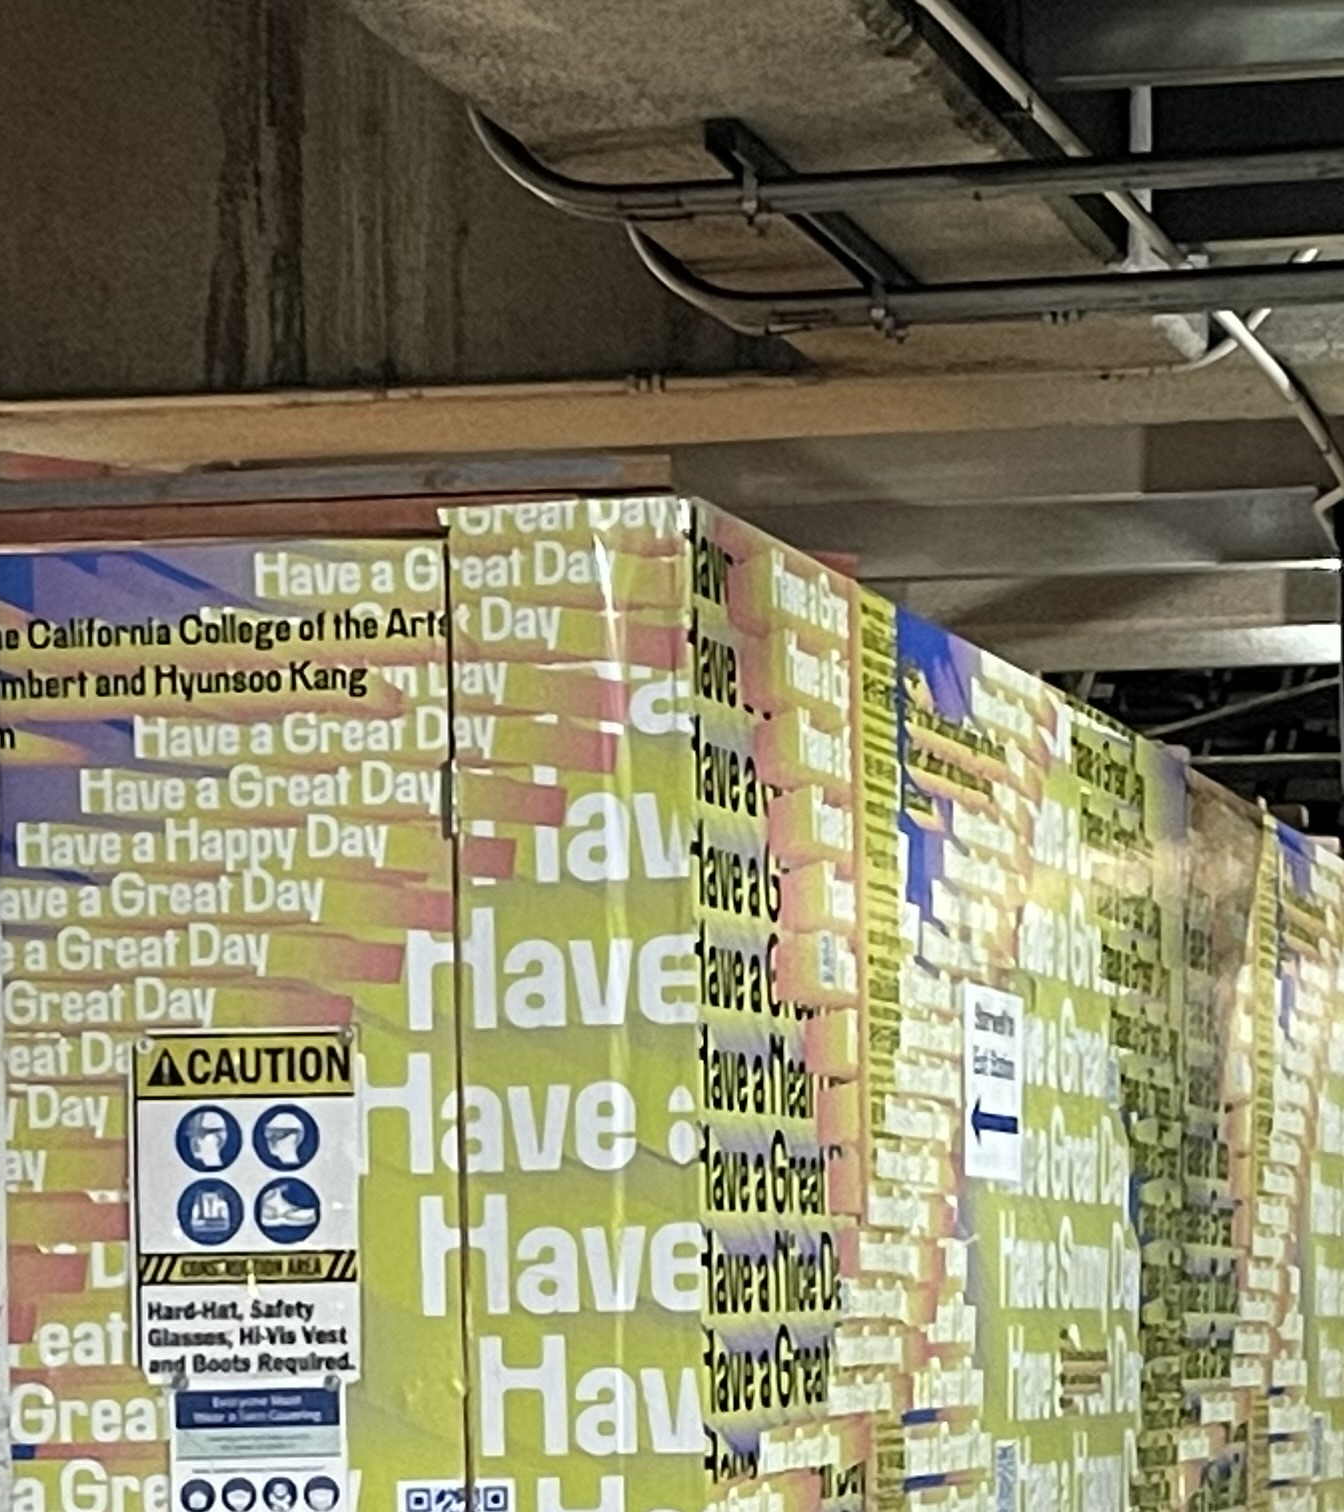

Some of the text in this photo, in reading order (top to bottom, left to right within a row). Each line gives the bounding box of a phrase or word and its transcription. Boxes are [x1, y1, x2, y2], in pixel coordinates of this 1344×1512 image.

[254, 551, 365, 599] Have
[371, 561, 393, 591] a
[27, 617, 171, 653] California
[179, 614, 292, 650] College
[298, 609, 327, 642] of
[333, 611, 379, 641] the
[96, 667, 146, 697] and
[155, 665, 282, 701] Hyunsoo
[290, 661, 368, 697] Kang
[132, 706, 497, 760] Have a Great Day
[80, 760, 443, 816] Have a Great Day
[16, 812, 389, 872] Have a Happy Day
[186, 1045, 350, 1084] CAUTION
[27, 1086, 108, 1138] Day
[251, 1299, 315, 1323] Safety
[147, 1329, 234, 1349] Glasses,
[302, 1326, 348, 1346] Vest
[148, 1352, 356, 1376] and Boots Required.
[479, 1335, 708, 1457] Hav
